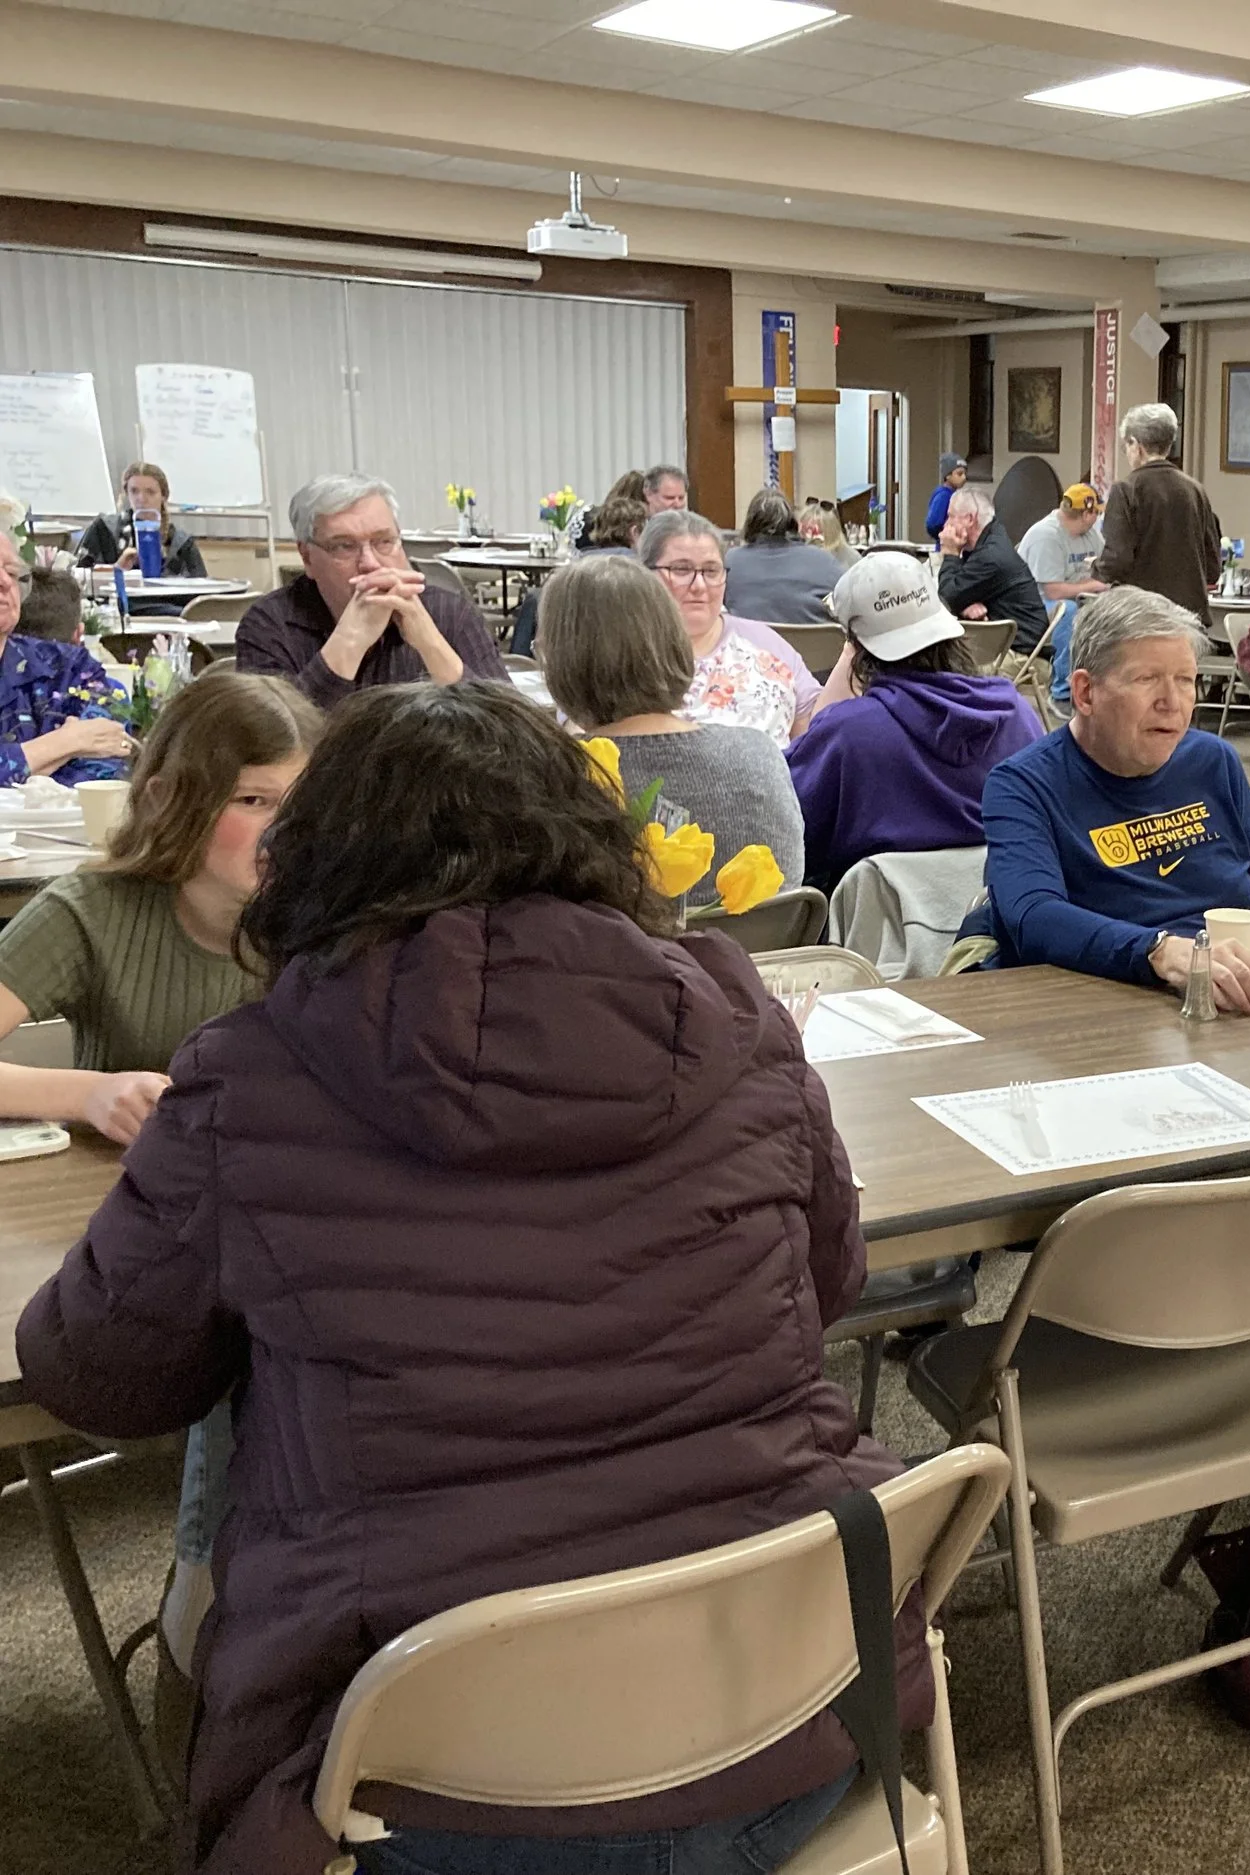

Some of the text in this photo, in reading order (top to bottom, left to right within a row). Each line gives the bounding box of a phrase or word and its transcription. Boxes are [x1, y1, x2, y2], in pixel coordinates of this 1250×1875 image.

[1106, 312, 1116, 405] JUSTICE
[1129, 806, 1210, 838] MILWAUKEE
[1134, 822, 1206, 851] BREWERS
[1155, 831, 1221, 857] BASEBALL
